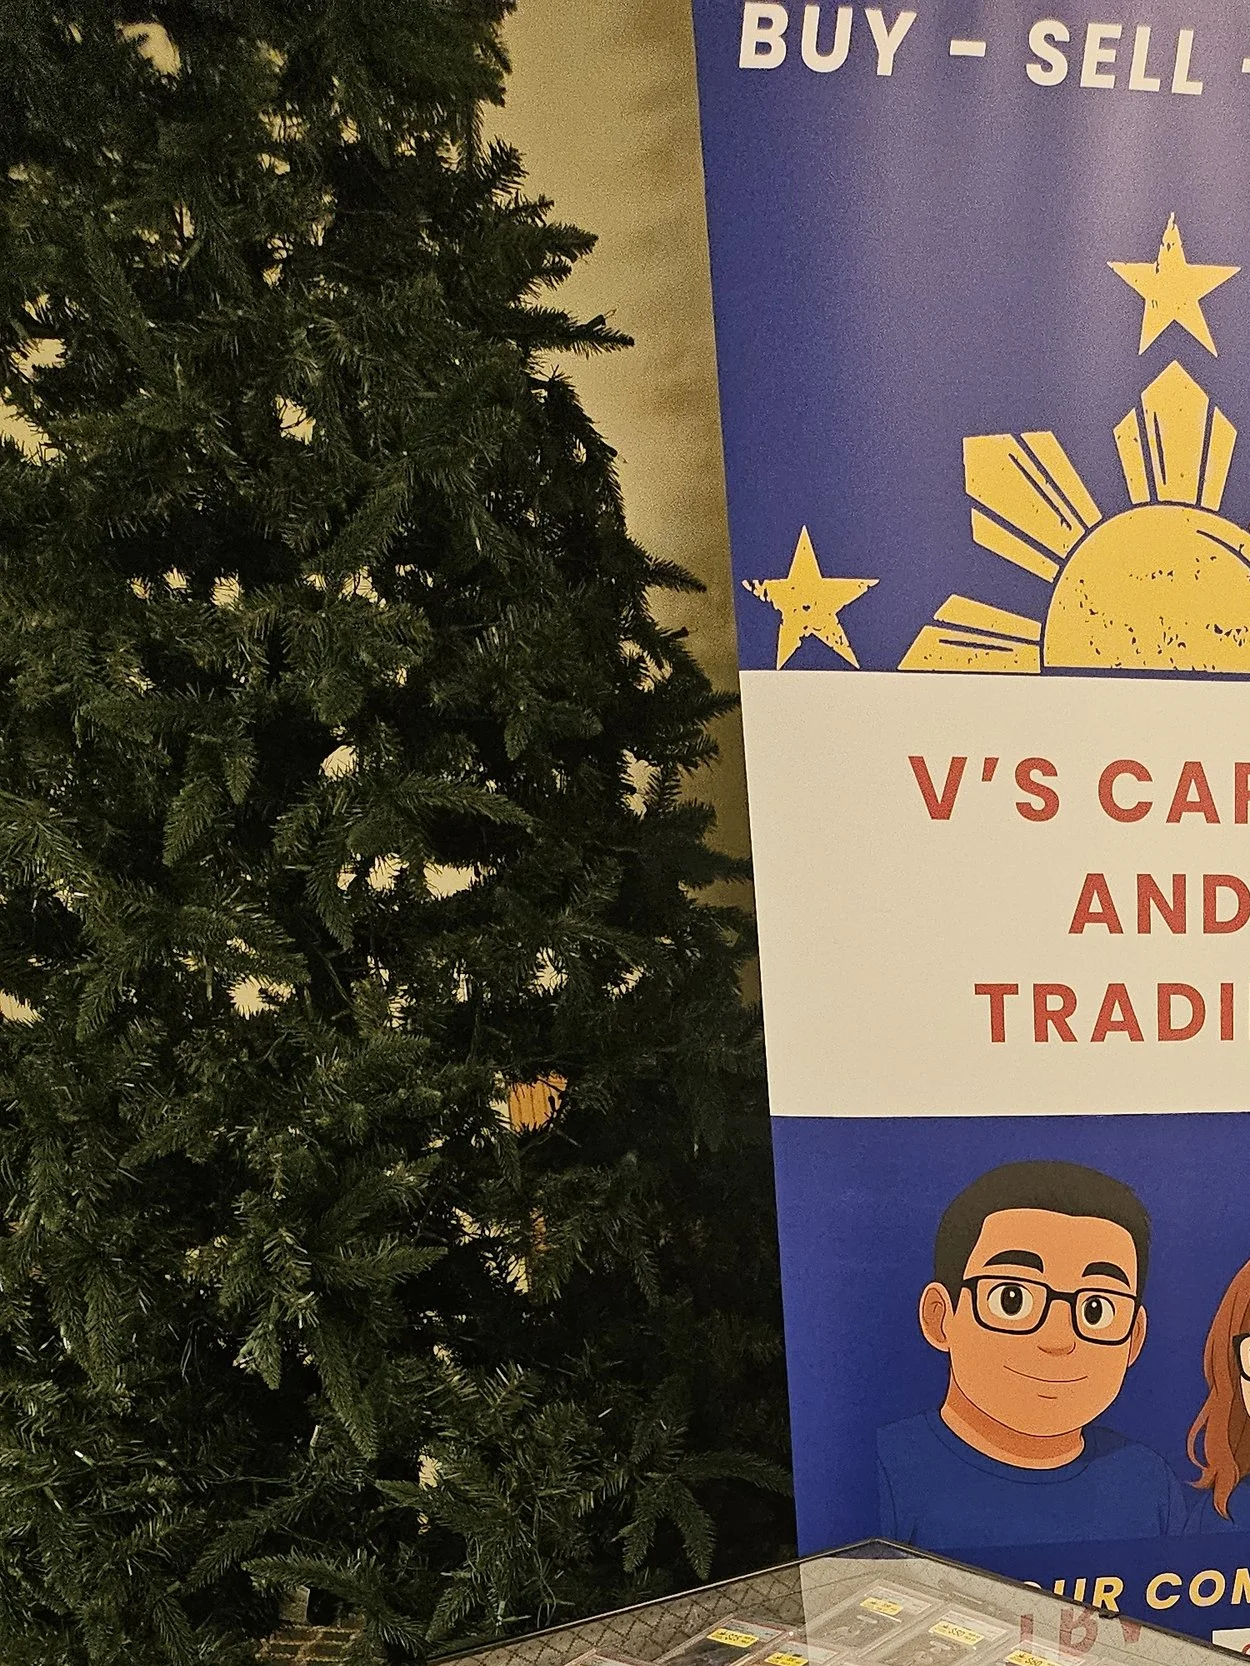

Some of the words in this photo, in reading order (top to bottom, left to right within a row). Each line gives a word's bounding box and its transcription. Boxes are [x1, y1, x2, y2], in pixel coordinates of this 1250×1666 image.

[738, 2, 920, 77] BUY
[1025, 20, 1205, 95] SELL
[1023, 1577, 1124, 1613] UR
